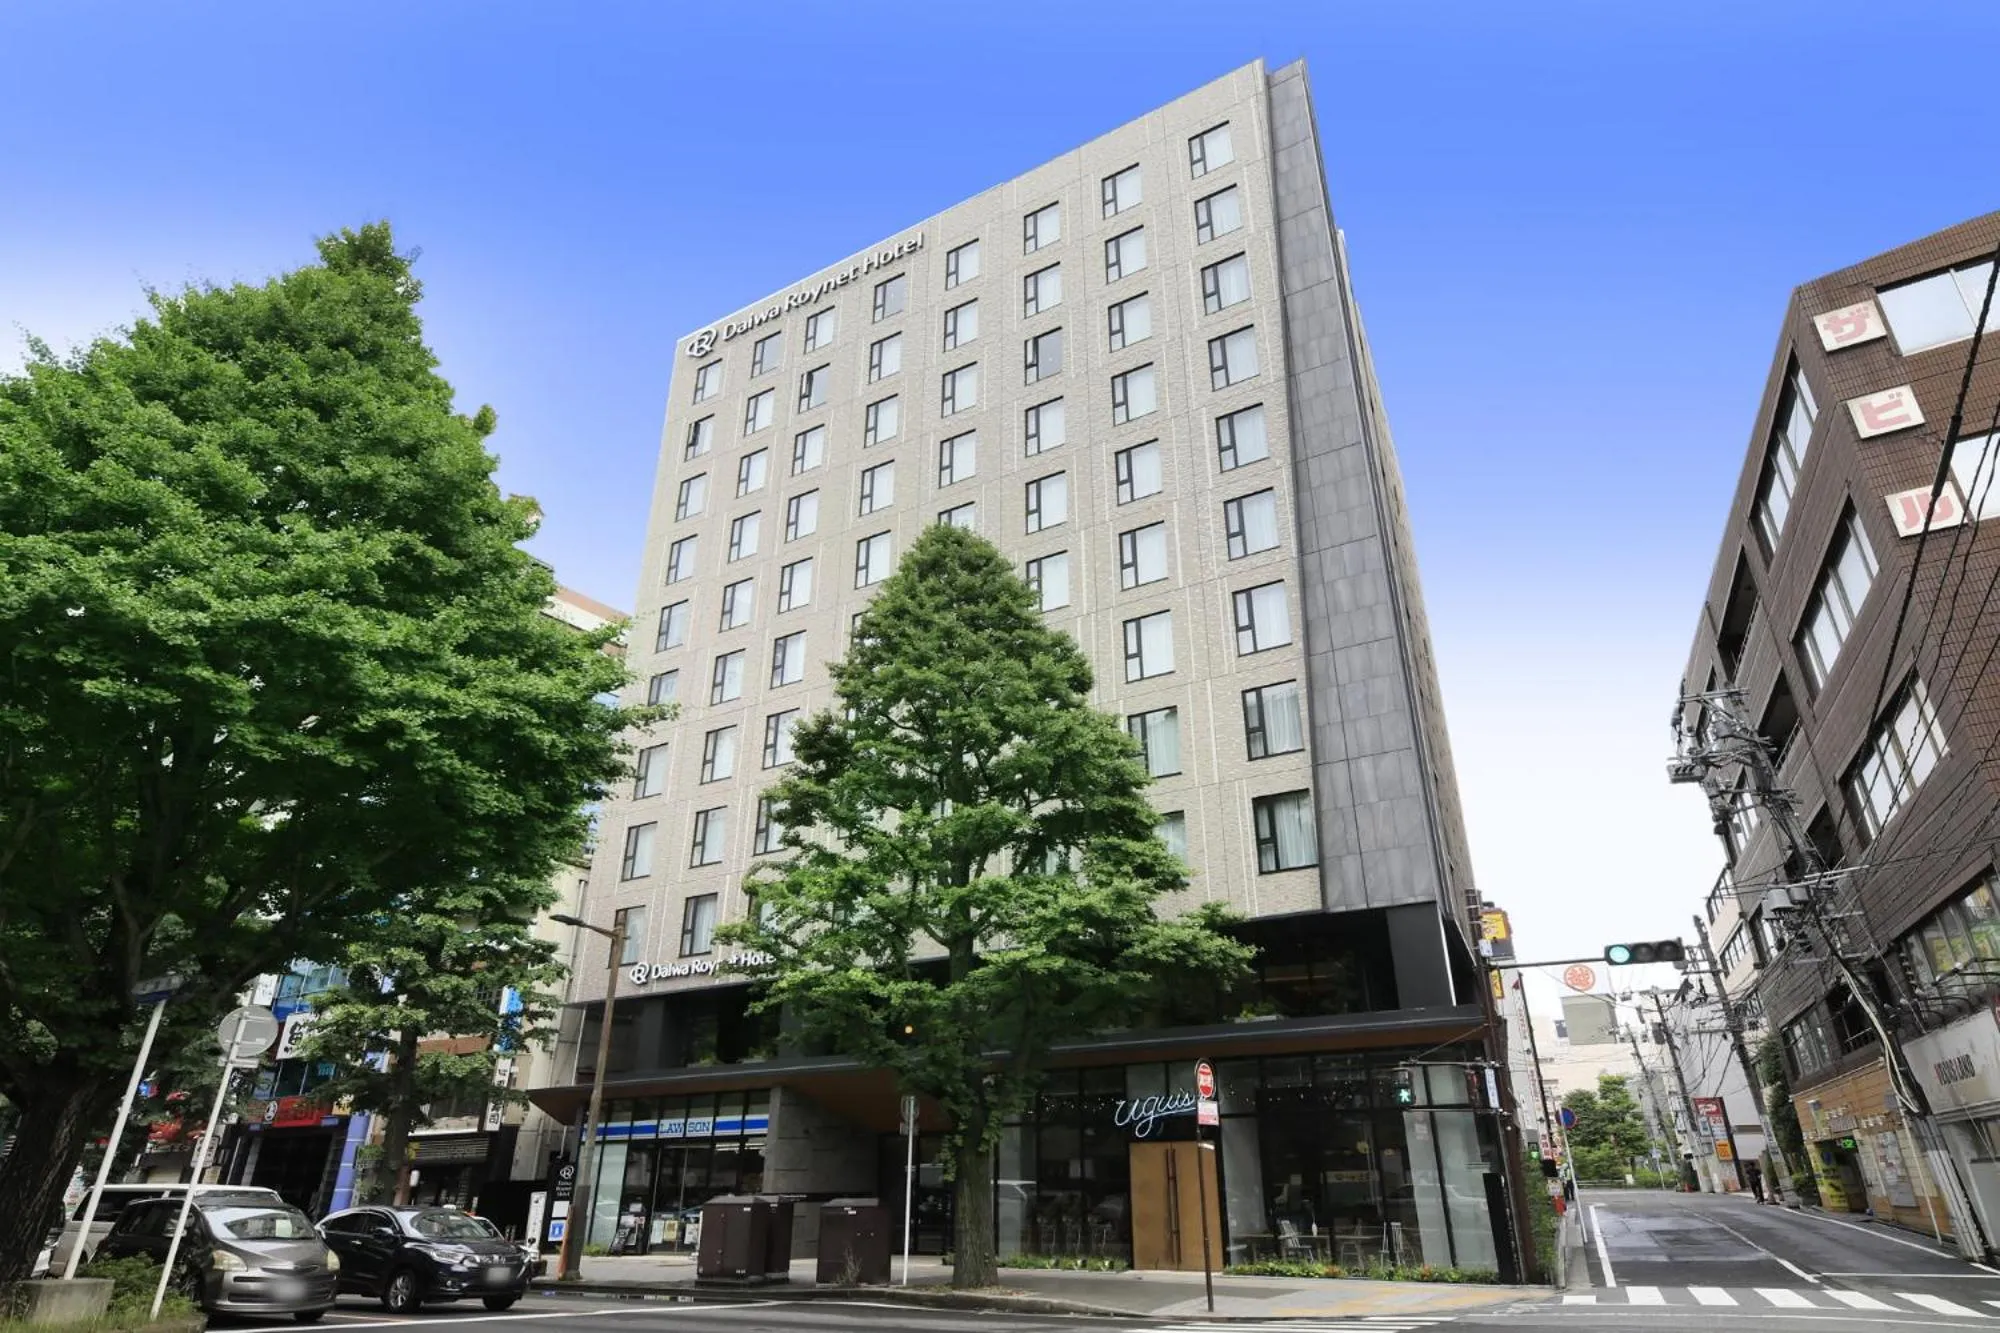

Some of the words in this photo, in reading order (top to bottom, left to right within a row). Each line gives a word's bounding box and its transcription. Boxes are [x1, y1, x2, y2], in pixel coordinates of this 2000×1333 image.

[723, 304, 782, 341] Daiwa
[784, 264, 860, 312] Roynet
[862, 231, 924, 274] Hotel
[651, 963, 690, 979] Daiwa
[741, 950, 777, 967] Hote
[660, 1121, 711, 1134] LAWSON
